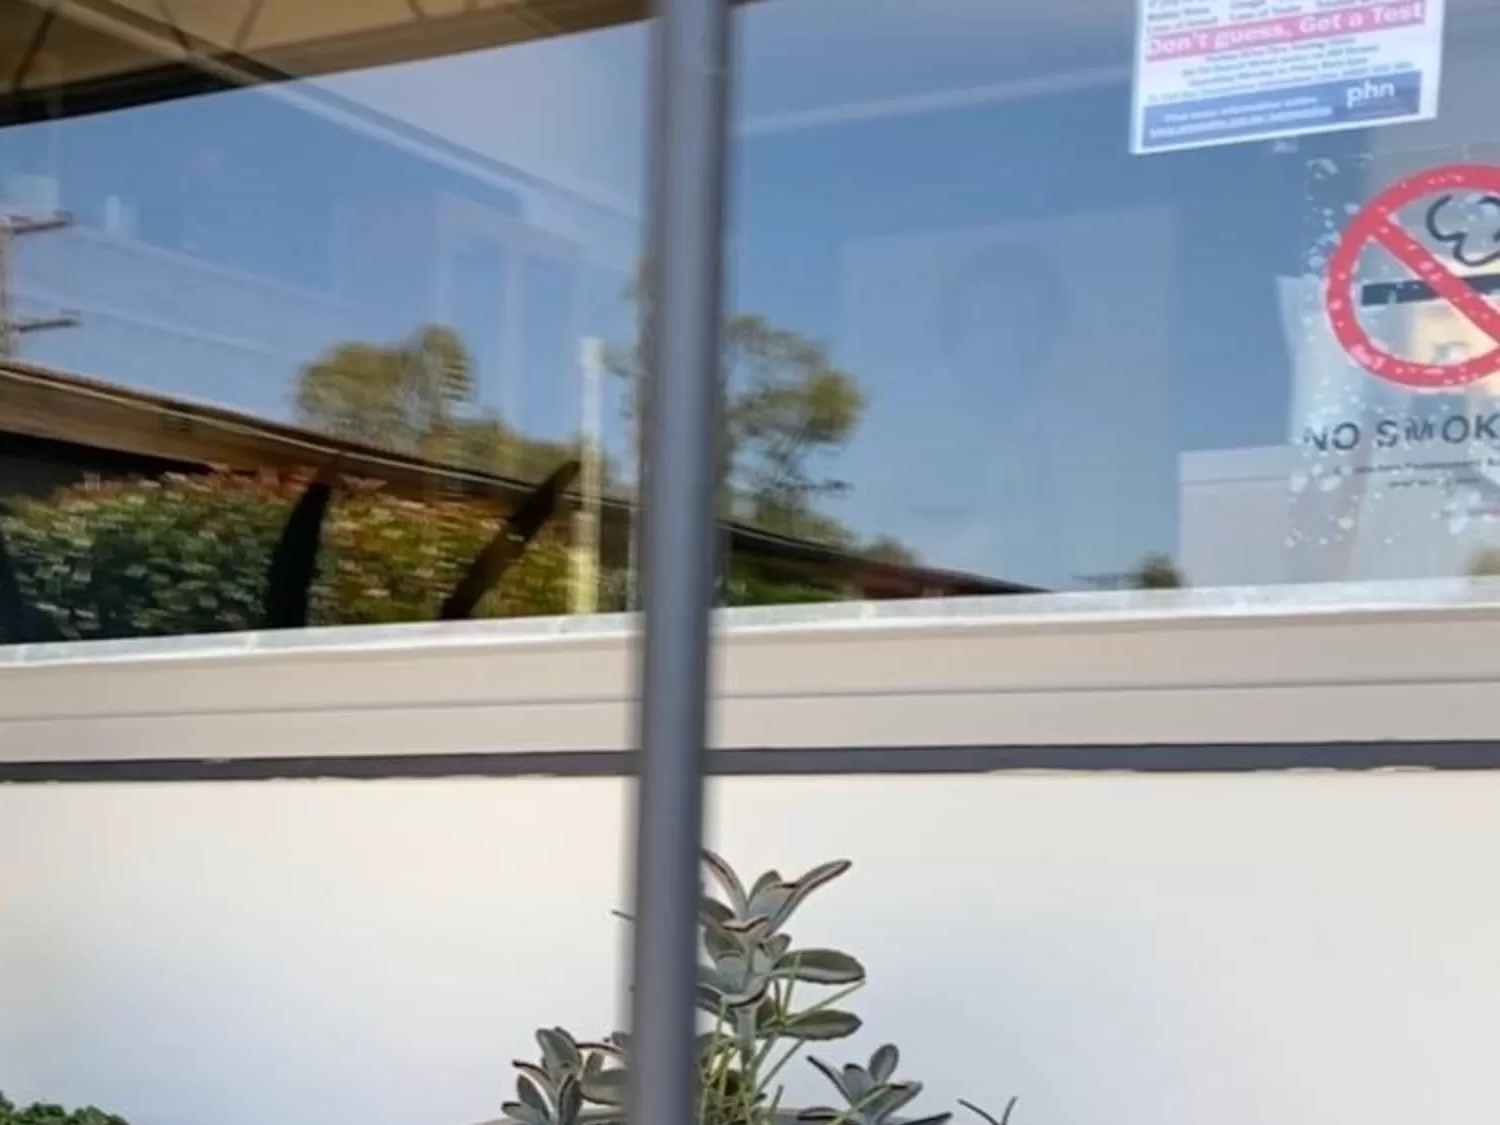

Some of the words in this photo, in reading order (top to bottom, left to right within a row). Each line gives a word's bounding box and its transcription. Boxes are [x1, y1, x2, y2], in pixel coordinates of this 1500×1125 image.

[1299, 13, 1342, 33] Get
[1347, 12, 1365, 27] a
[1372, 3, 1422, 24] Test
[1346, 79, 1396, 108] phn
[1303, 421, 1361, 452] NO
